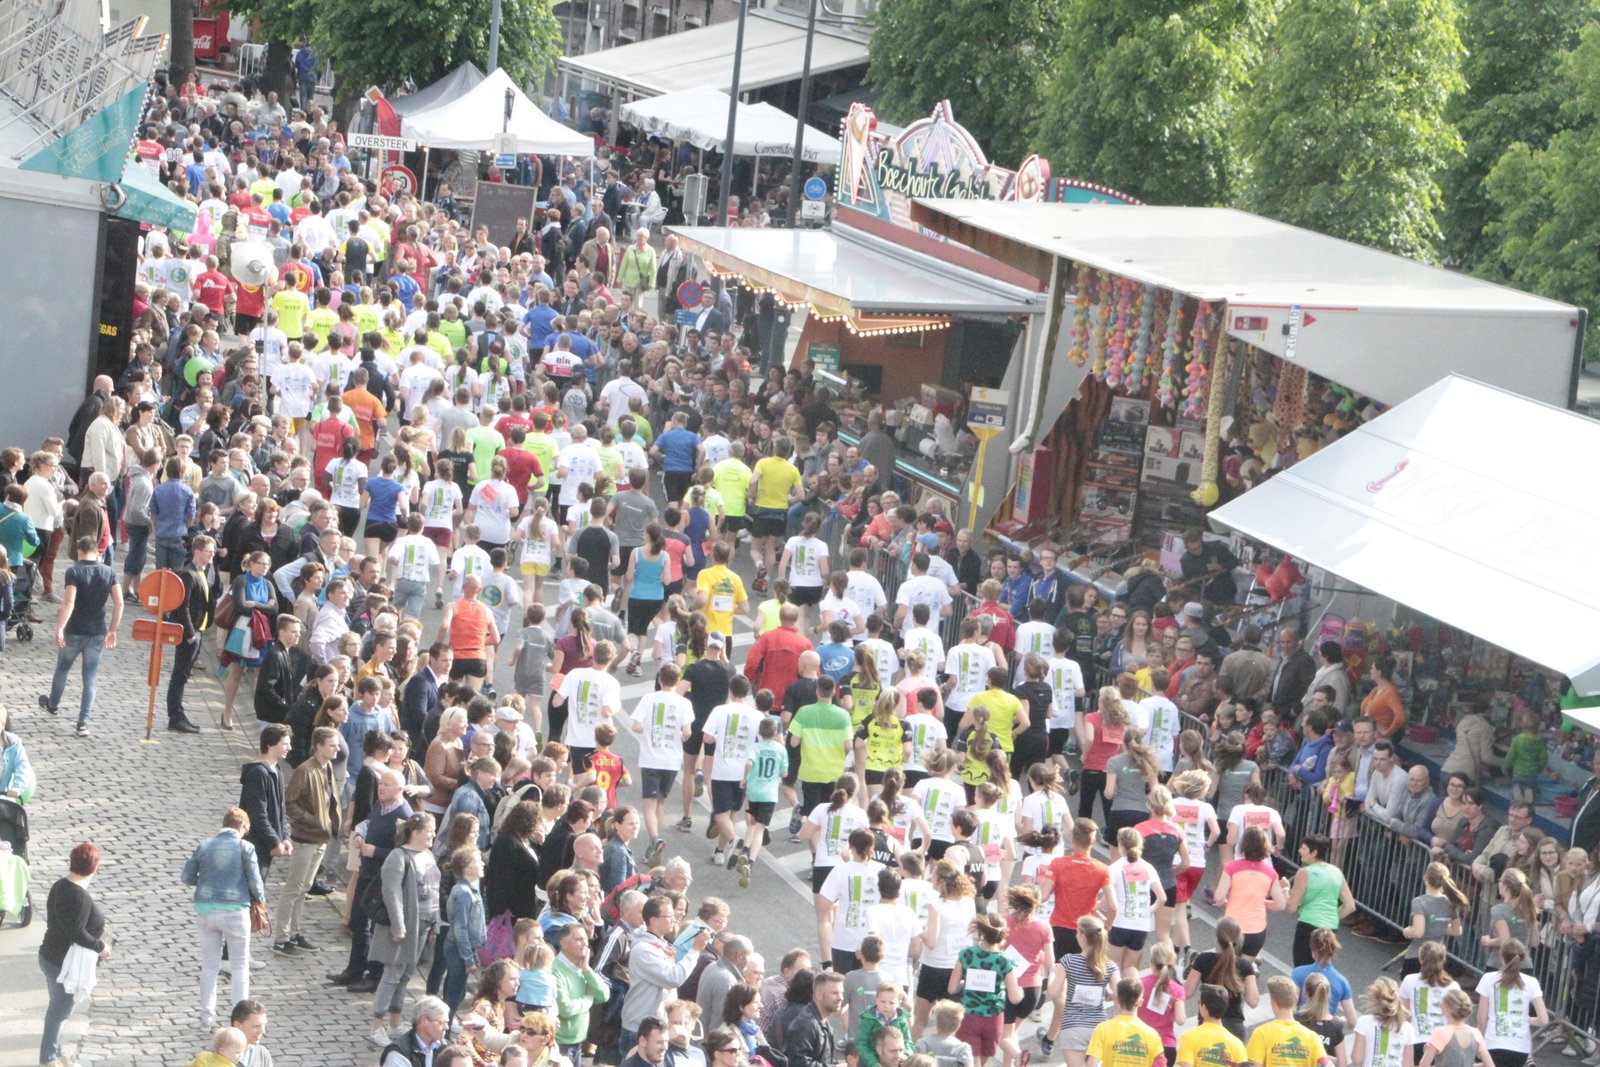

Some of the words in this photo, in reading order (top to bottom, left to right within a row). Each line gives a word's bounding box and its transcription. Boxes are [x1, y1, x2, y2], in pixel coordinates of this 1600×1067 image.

[355, 135, 408, 149] OVERSTEEK
[754, 141, 797, 157] Corsendo
[758, 756, 776, 778] 10
